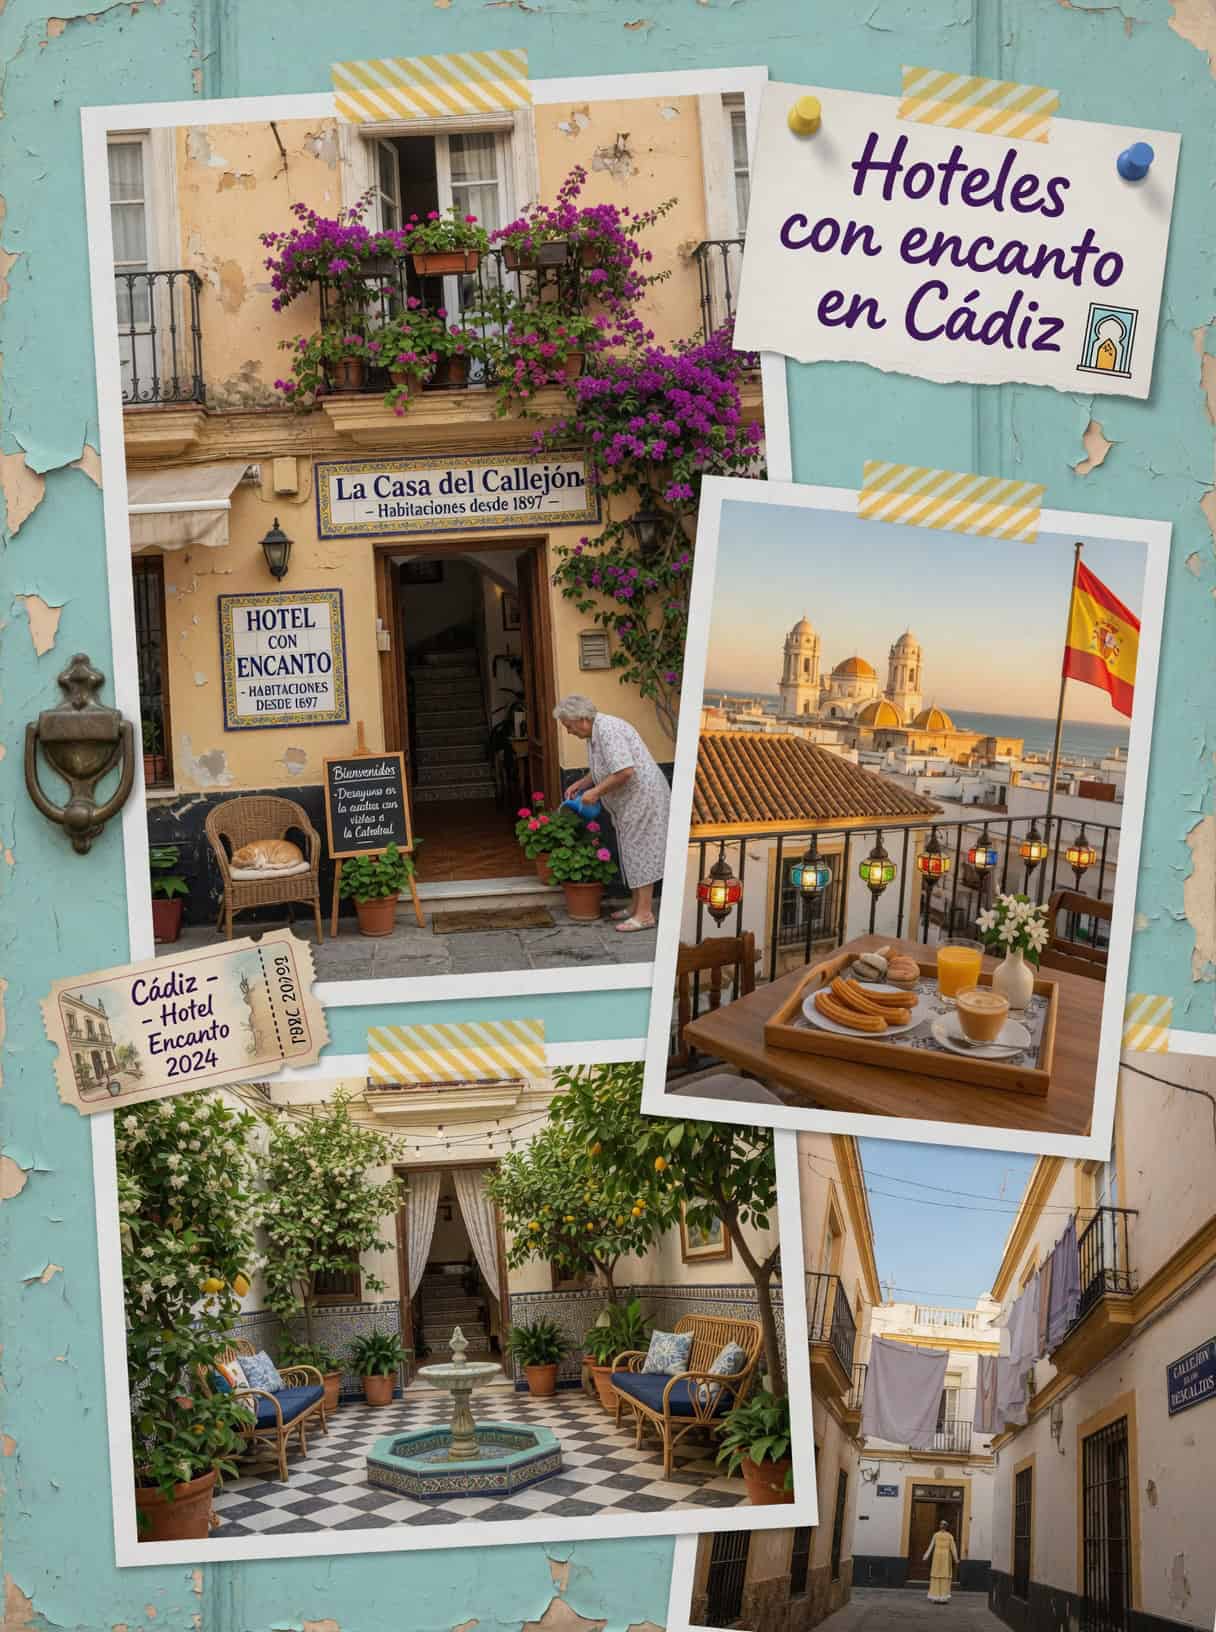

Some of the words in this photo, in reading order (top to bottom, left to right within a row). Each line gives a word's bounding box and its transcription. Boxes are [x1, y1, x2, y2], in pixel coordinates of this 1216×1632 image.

[852, 131, 1071, 218] Hoteles
[780, 212, 882, 256] con
[900, 227, 1124, 287] encanto
[817, 289, 886, 329] en
[905, 279, 1065, 353] Cádiz
[336, 477, 367, 500] La
[373, 474, 432, 498] Casa
[439, 470, 474, 494] del
[378, 499, 466, 518] Habitaciones
[470, 497, 509, 513] desde
[513, 495, 543, 511] 1897
[246, 607, 316, 631] HOTEL
[268, 634, 297, 649] CON
[237, 651, 332, 678] ENCANTO
[249, 681, 329, 697] HABITACIONES
[256, 698, 292, 711] DESDE
[131, 970, 198, 1006] Cádiz
[160, 994, 214, 1027] Hotel
[148, 1019, 230, 1055] Encanto
[166, 1048, 219, 1077] 2024
